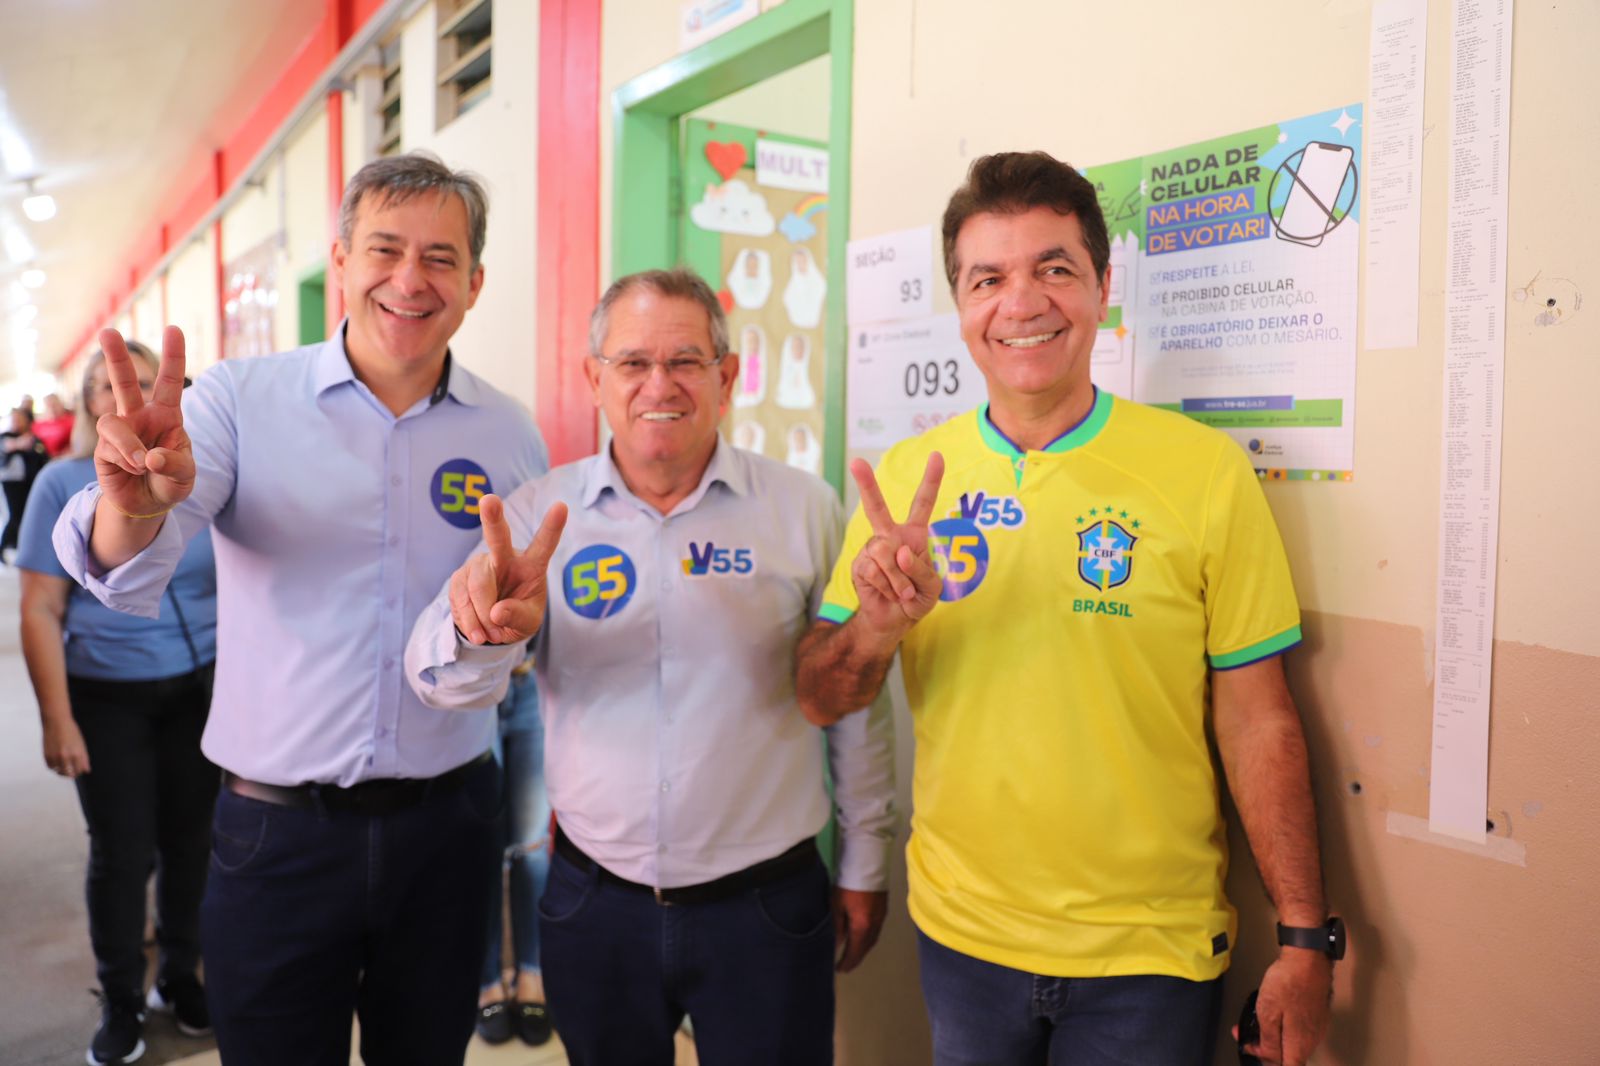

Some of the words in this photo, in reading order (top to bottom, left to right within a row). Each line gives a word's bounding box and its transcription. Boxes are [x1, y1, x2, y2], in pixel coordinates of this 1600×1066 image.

[1151, 153, 1219, 182] NADA
[1225, 144, 1259, 168] DE
[1151, 165, 1261, 203] CELULAR
[1150, 205, 1181, 227] NA
[1184, 193, 1251, 219] HORA
[1149, 229, 1177, 252] DE
[1180, 219, 1265, 248] VOTAR!
[855, 246, 896, 269] SEÇÃO
[1161, 264, 1218, 283] RESPEITE
[1221, 263, 1230, 275] A
[1233, 260, 1255, 274] LEI.
[901, 279, 922, 303] 93
[1161, 290, 1168, 305] É
[1172, 285, 1230, 302] PROIBIDO
[1233, 278, 1295, 297] CELULAR
[1161, 305, 1177, 318] NA
[1180, 301, 1227, 317] CABINA
[1230, 299, 1248, 312] DE
[1251, 289, 1318, 311] VOTAÇÃO.
[1160, 324, 1168, 338] É
[1170, 317, 1254, 338] OBRIGATÓRIO
[1258, 313, 1309, 330] DEIXAR
[1313, 312, 1324, 325] O
[1160, 336, 1223, 351] APARELHO
[1226, 332, 1257, 348] COM
[1260, 331, 1271, 345] O
[1273, 326, 1342, 345] MESÁRIO.
[904, 359, 960, 398] 093
[440, 472, 487, 515] 55
[685, 541, 753, 576] V55
[1094, 548, 1117, 558] CBF
[571, 554, 627, 607] 55
[1072, 599, 1133, 618] BRASIL
